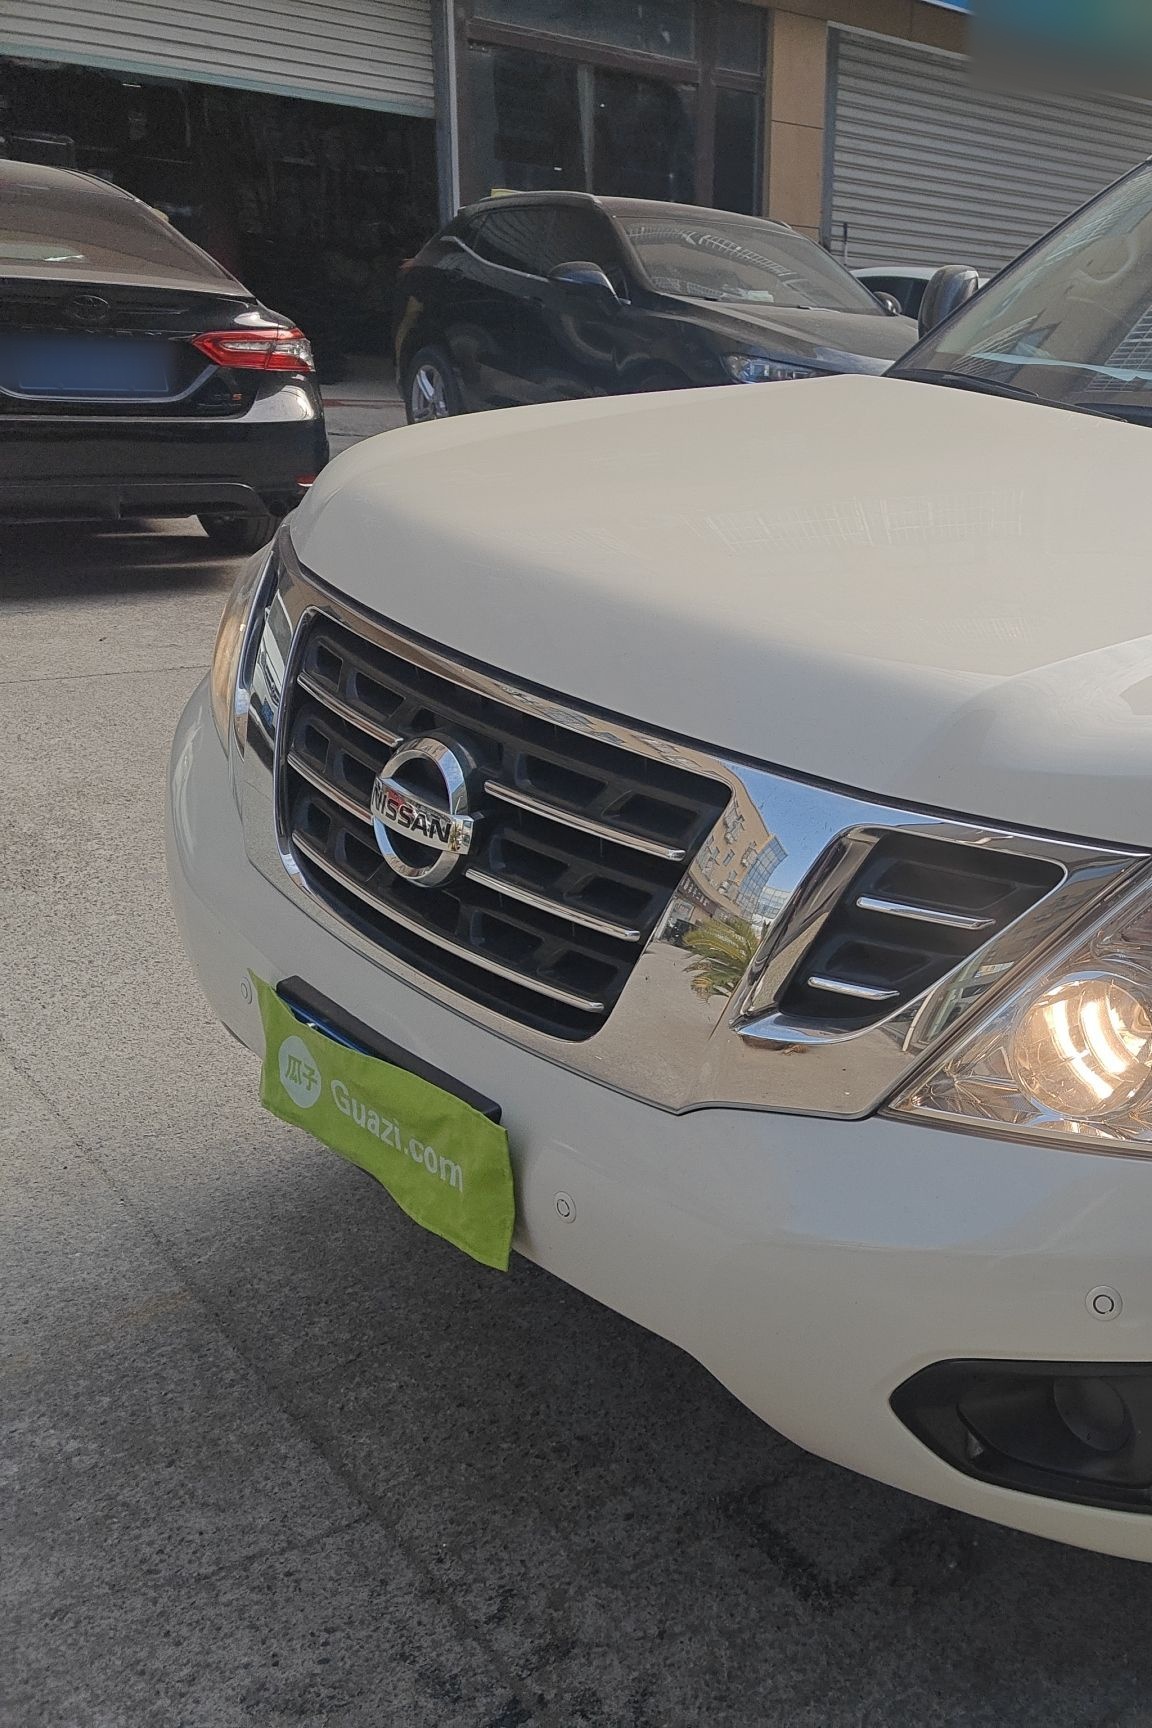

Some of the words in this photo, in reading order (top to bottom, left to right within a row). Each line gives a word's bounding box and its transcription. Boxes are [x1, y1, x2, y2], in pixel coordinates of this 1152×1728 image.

[372, 780, 452, 843] NISSAN
[286, 1055, 318, 1091] 瓜子
[331, 1080, 463, 1192] Guazi.com
